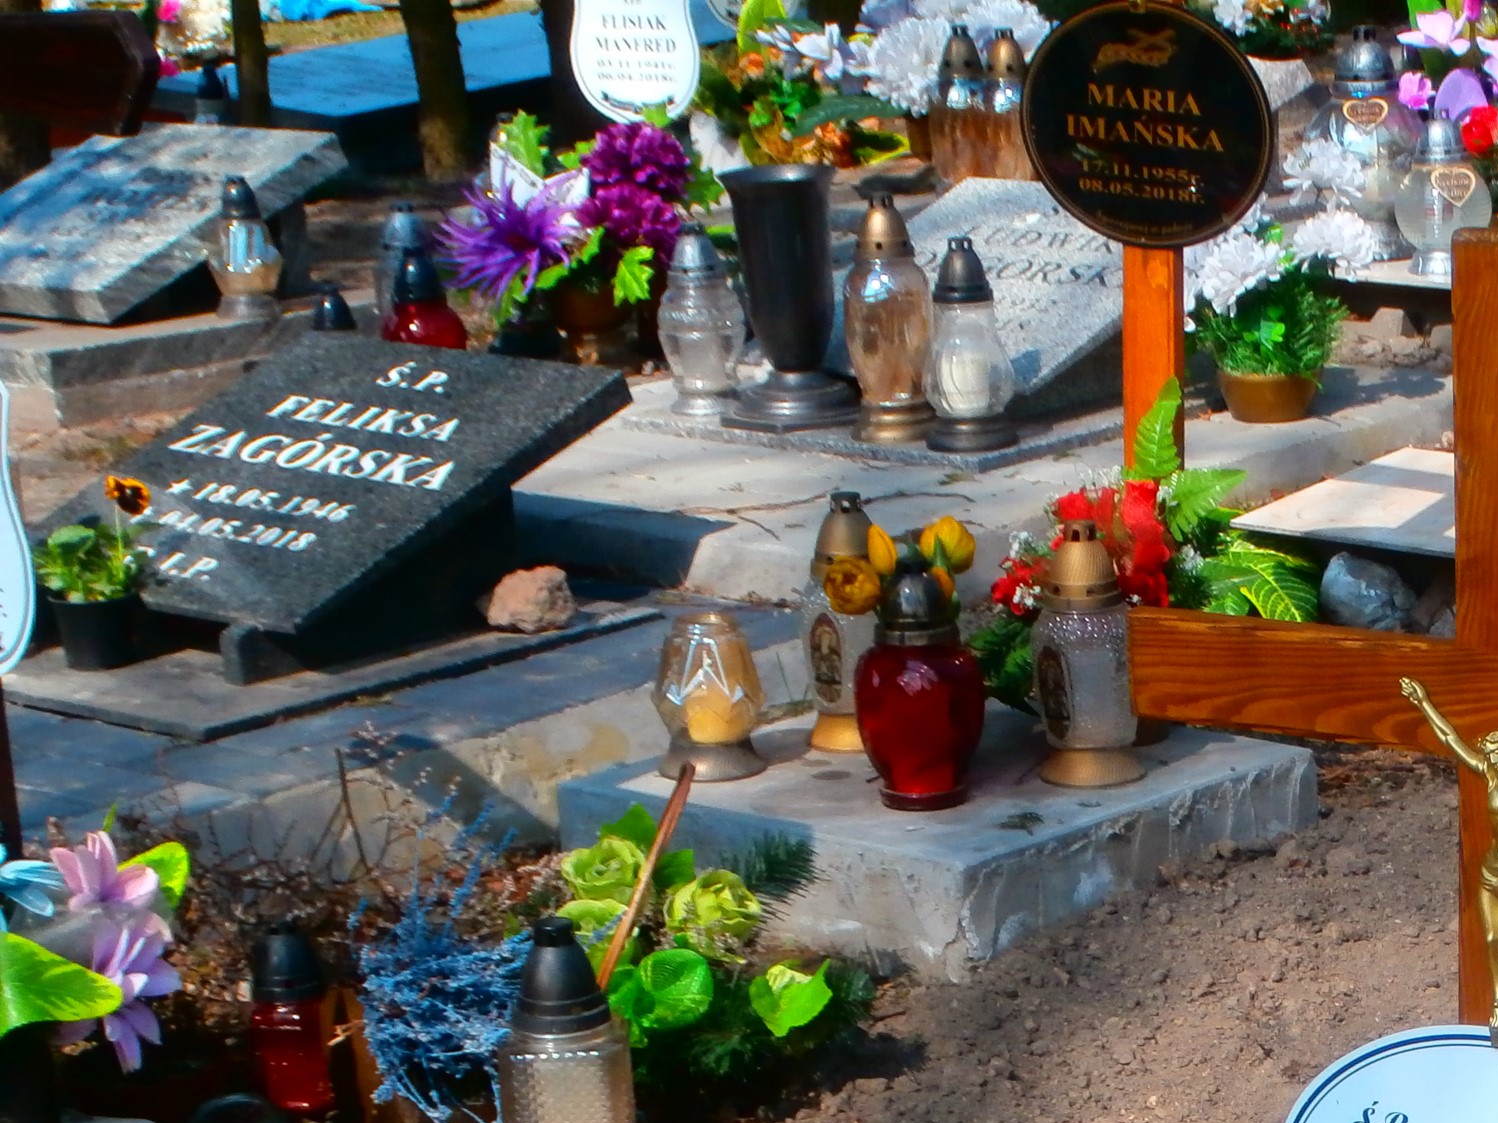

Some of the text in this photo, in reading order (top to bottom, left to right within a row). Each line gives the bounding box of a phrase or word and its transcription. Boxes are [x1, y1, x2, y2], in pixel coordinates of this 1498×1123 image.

[595, 36, 676, 53] MANFRED
[1087, 82, 1202, 116] MARIA
[1066, 113, 1225, 153] IMAŃSKA
[376, 360, 450, 394] Ś.P.
[265, 394, 460, 442] FELIKSA
[167, 424, 456, 491] ZAGÓRSKA
[192, 482, 357, 523] 18.05.1946
[157, 510, 318, 552] 04.05.2018
